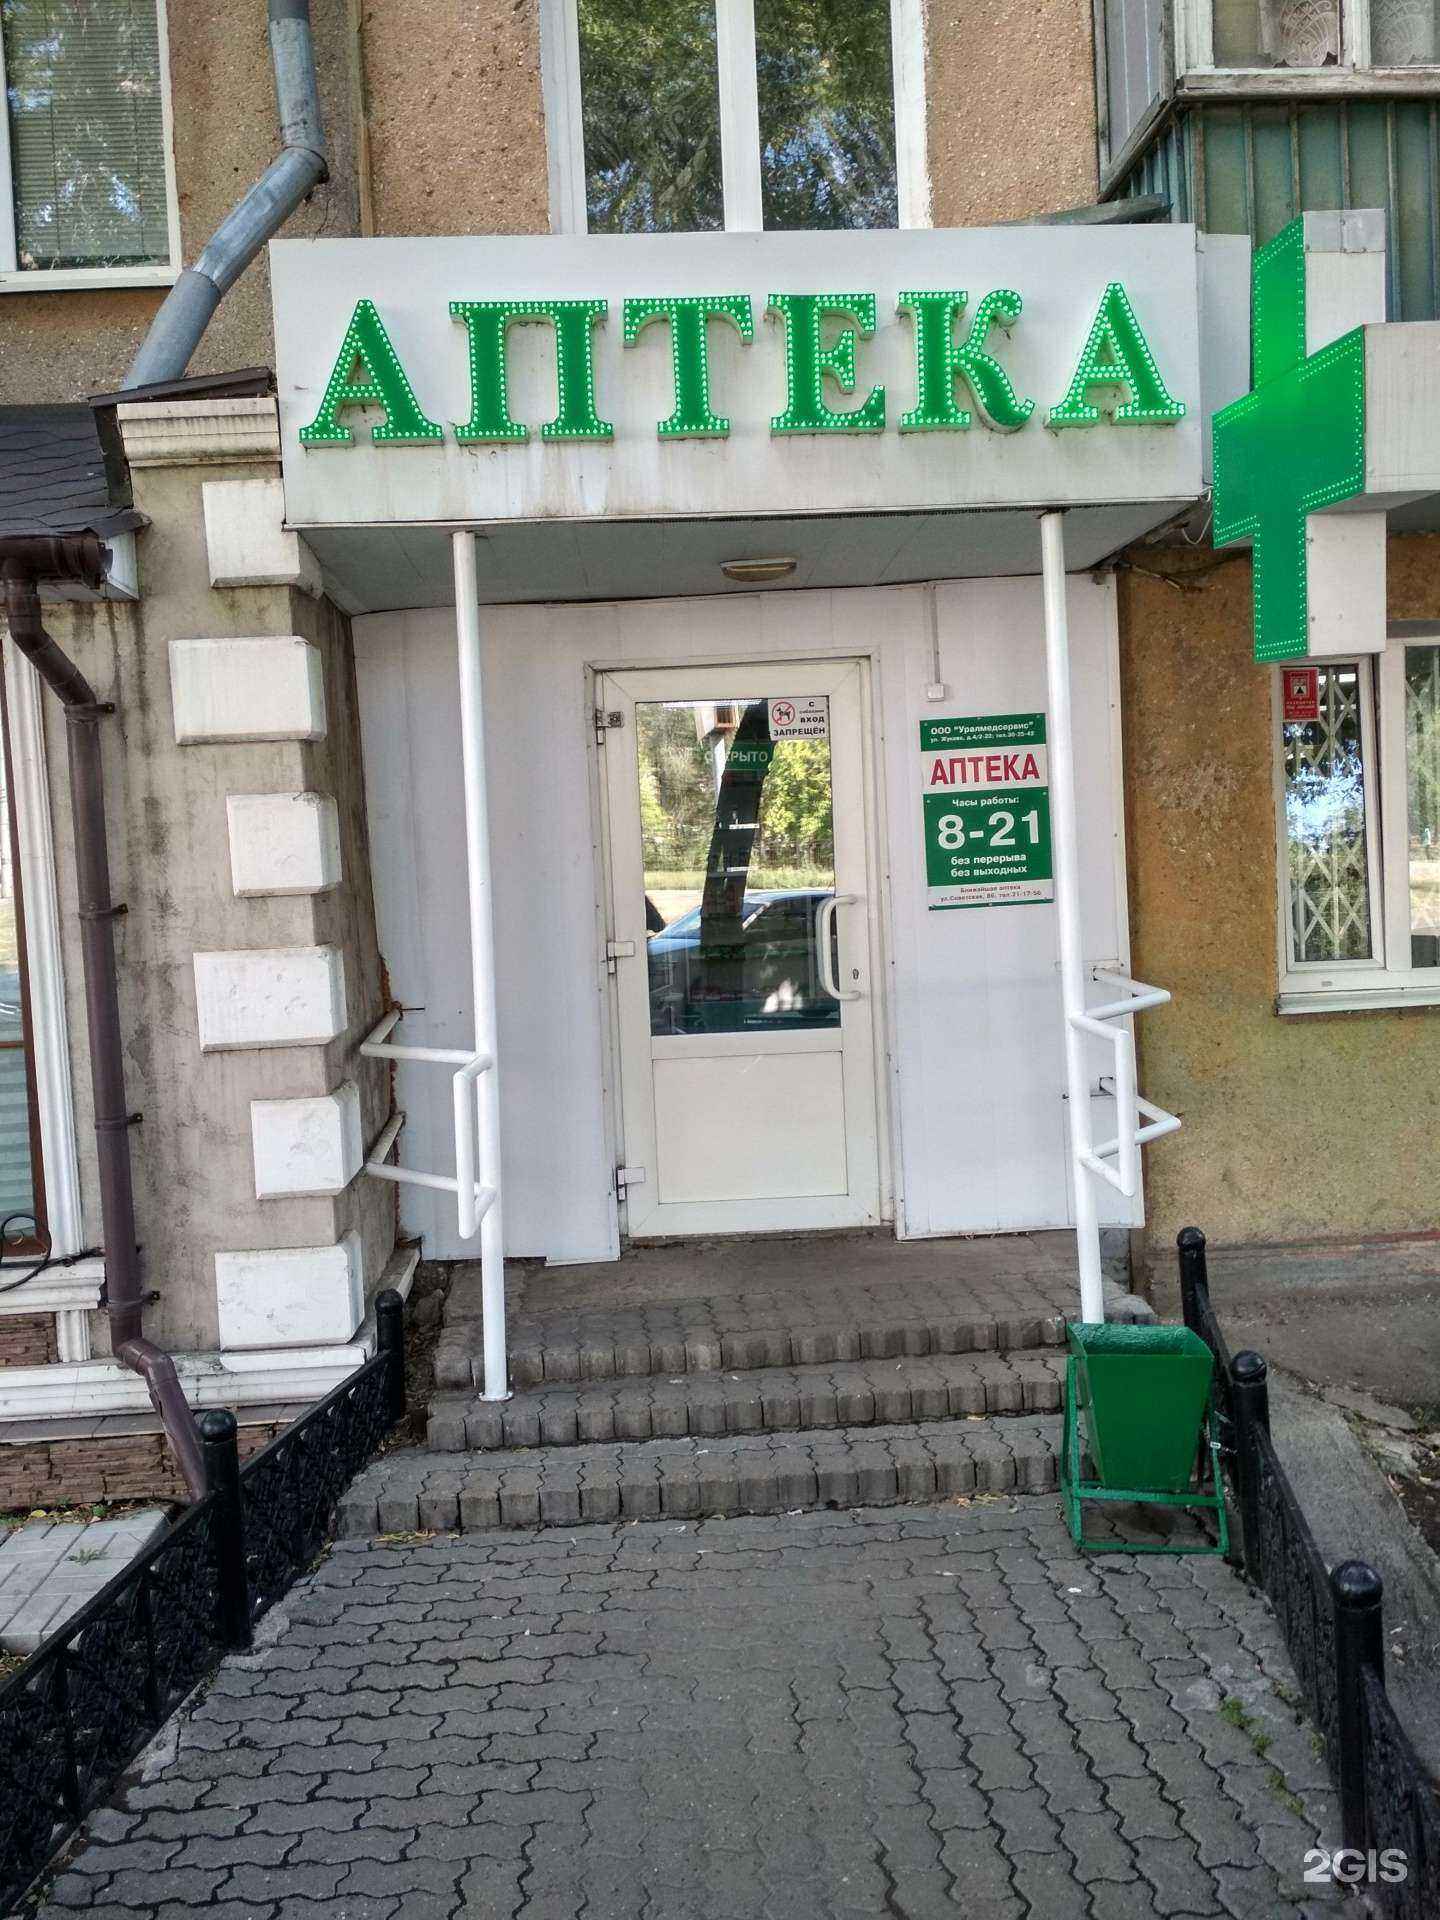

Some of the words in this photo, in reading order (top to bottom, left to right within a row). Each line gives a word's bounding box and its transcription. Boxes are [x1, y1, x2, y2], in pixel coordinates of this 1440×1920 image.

[299, 282, 1186, 447] АПТЕКА
[930, 726, 951, 735] ООО
[953, 721, 1034, 734] "Уралмедсервис"
[930, 753, 1040, 785] АПТЕКА
[952, 798, 977, 807] Часы
[980, 796, 1020, 807] работы:
[938, 810, 1039, 850] 8-21
[950, 856, 970, 866] без
[973, 854, 1027, 866] перерыва
[950, 868, 970, 878] без
[973, 866, 1028, 877] выходных
